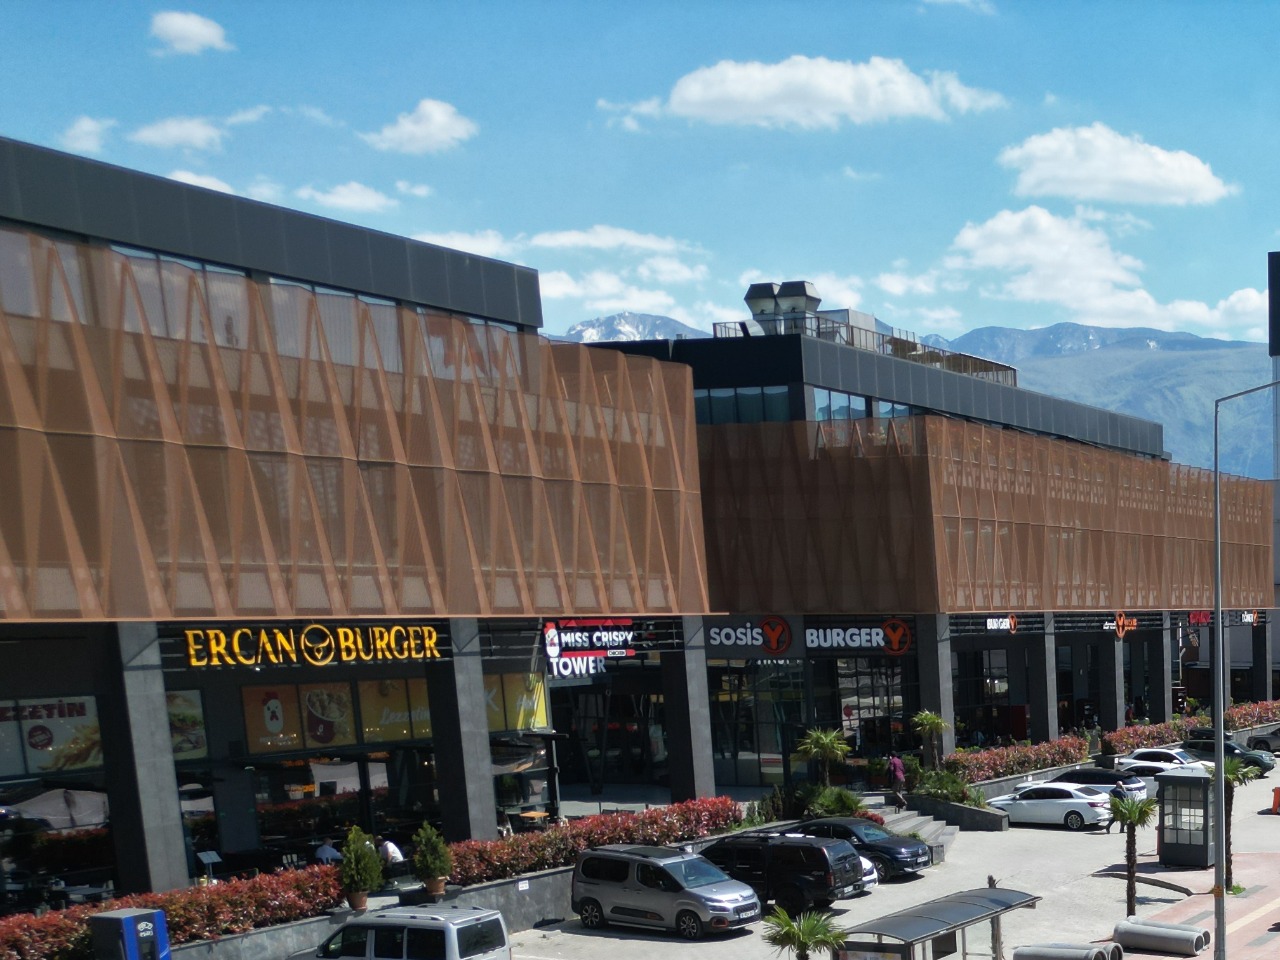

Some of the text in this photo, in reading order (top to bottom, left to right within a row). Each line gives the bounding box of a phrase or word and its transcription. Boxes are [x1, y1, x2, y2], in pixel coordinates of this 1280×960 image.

[185, 626, 442, 666] ERCAN BURGER
[560, 631, 634, 648] MISS CRISPY
[805, 627, 886, 648] BURGER
[549, 656, 607, 676] TOWER
